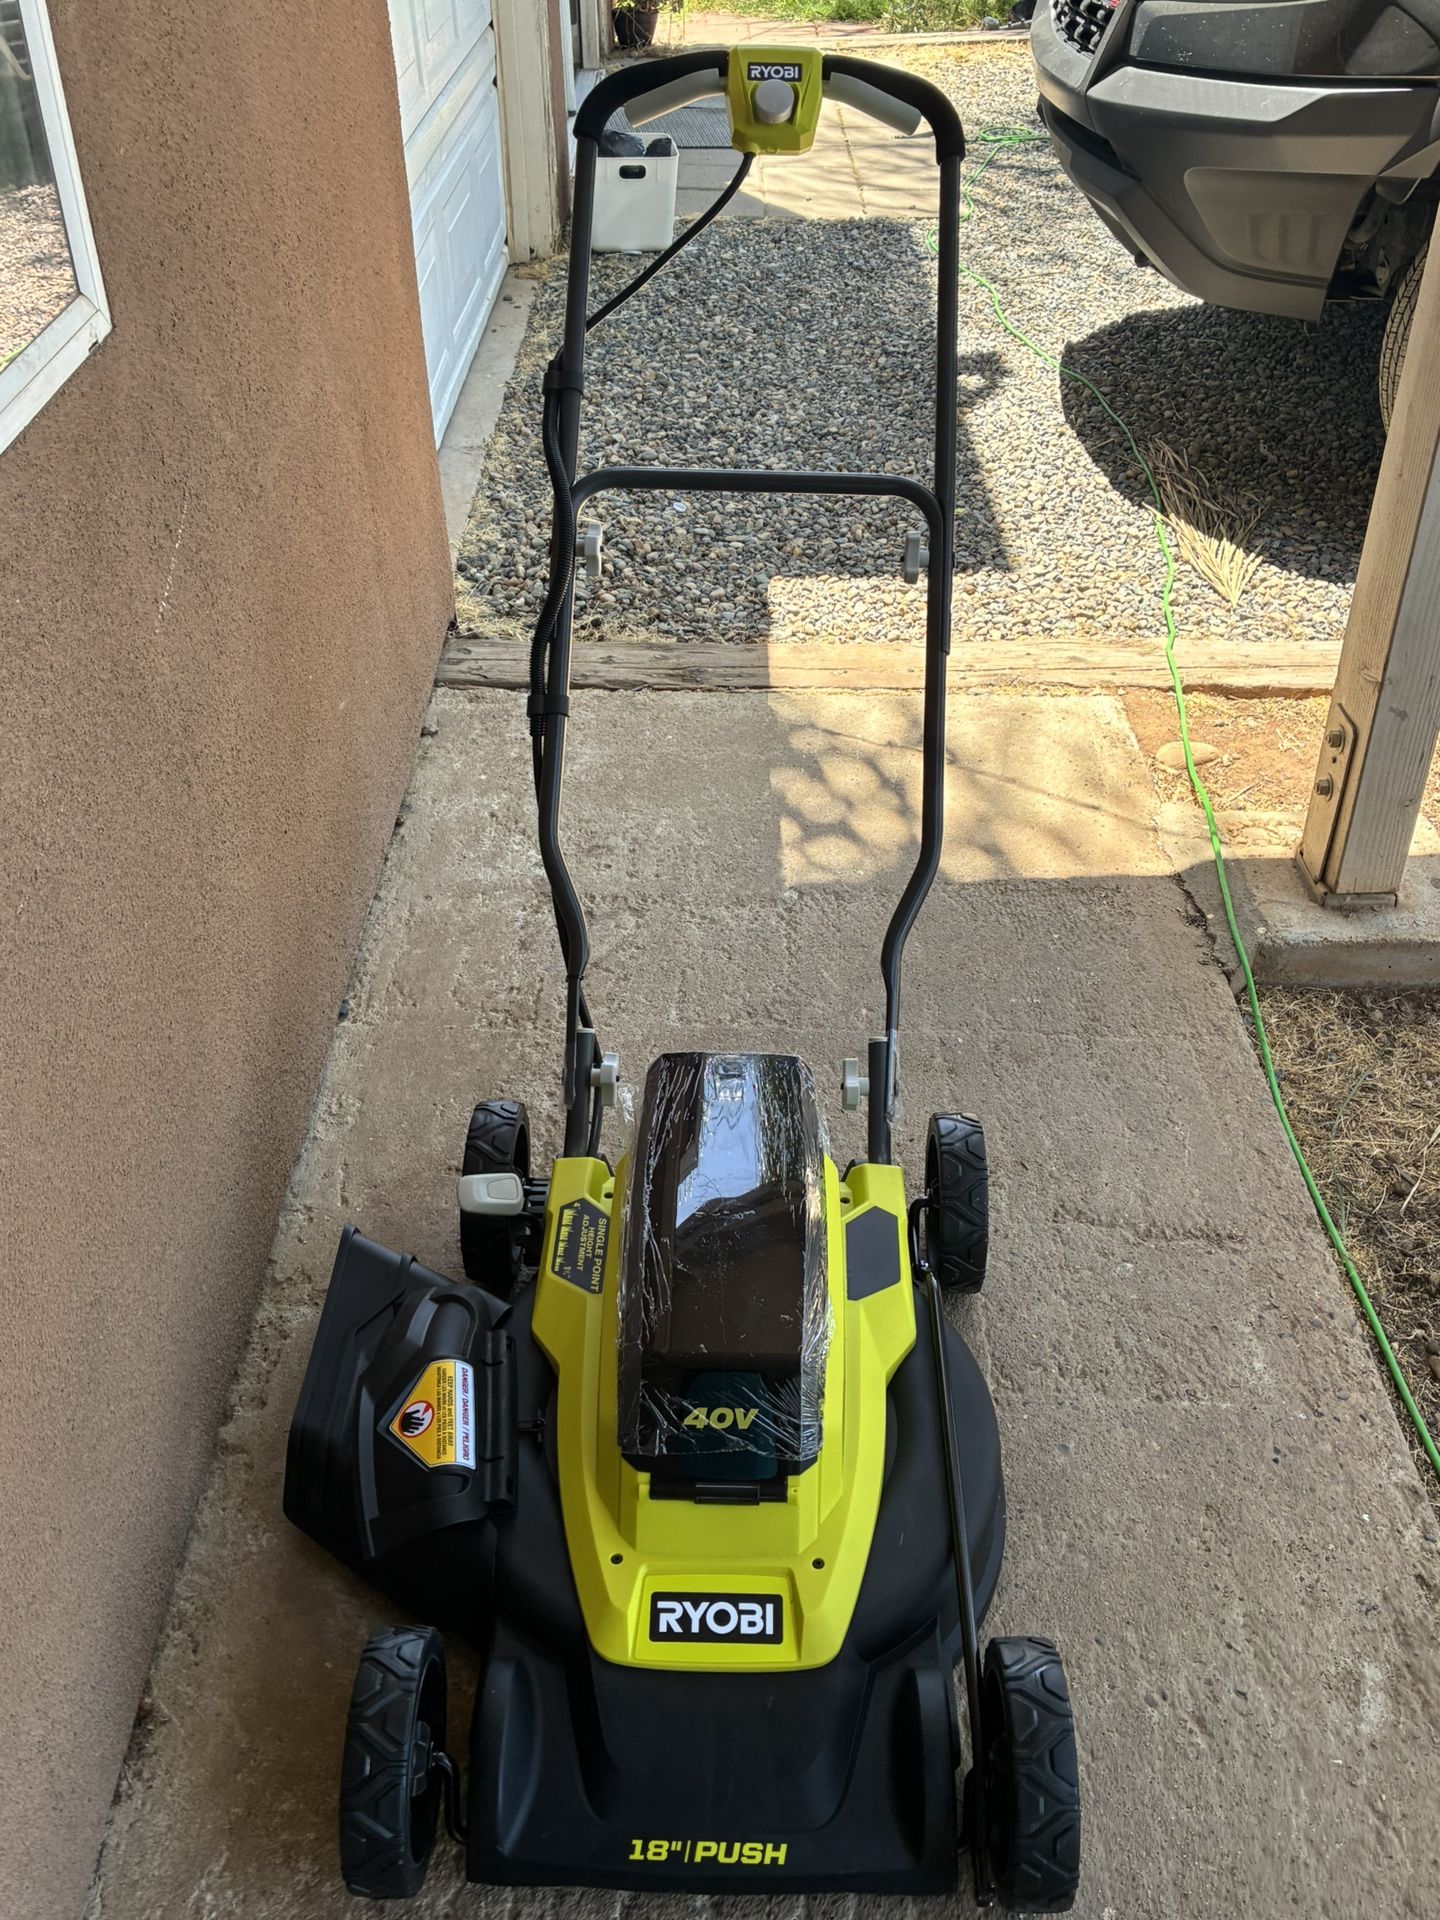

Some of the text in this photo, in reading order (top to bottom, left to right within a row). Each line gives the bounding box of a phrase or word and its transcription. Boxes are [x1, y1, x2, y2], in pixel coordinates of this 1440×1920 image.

[750, 65, 799, 78] RYOBI
[576, 1215, 590, 1271] ADJUSTMENT
[585, 1227, 596, 1258] HEIGHT
[590, 1218, 607, 1292] SINGLE POINT
[682, 1406, 760, 1430] 40V
[657, 1601, 774, 1636] RYOBI
[628, 1839, 788, 1866] 18" PUSH
